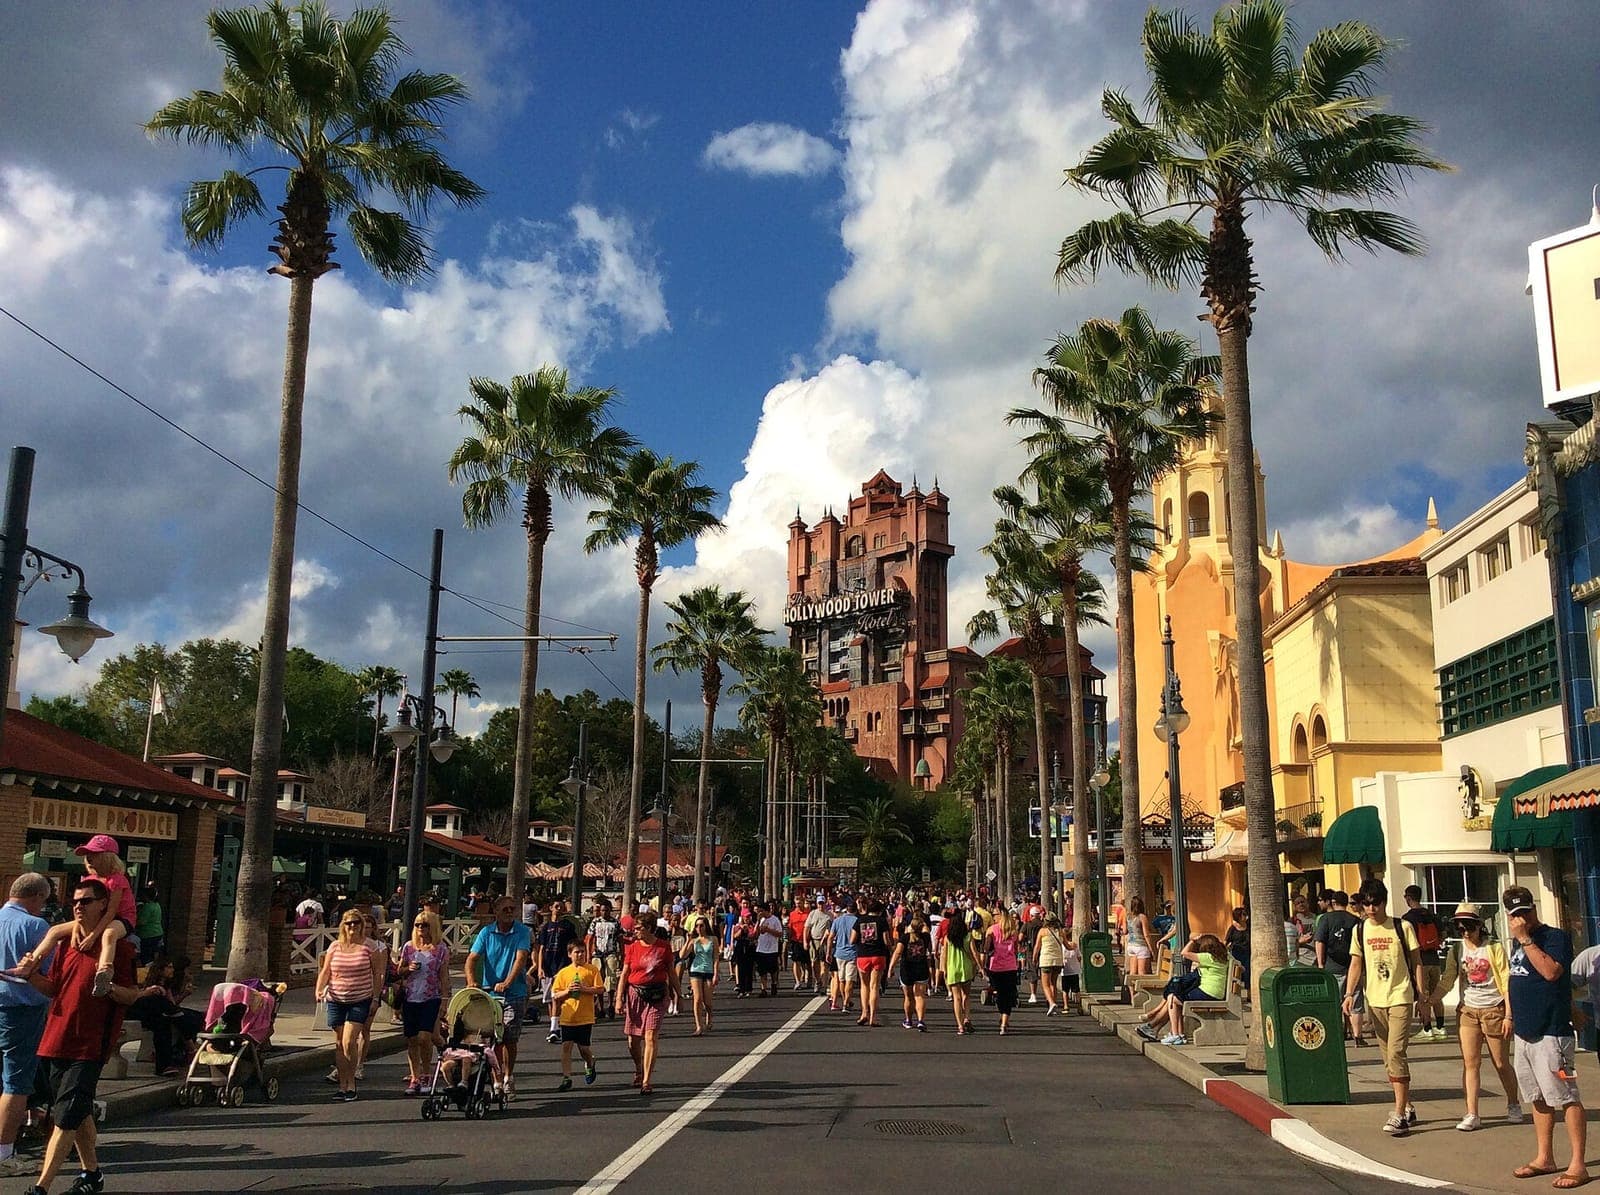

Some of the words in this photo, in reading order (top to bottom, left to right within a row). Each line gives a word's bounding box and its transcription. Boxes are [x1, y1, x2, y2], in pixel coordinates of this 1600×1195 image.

[783, 597, 851, 623] HOLLYWOOD
[855, 588, 895, 610] TOWER
[857, 607, 895, 631] Hotel
[106, 810, 172, 836] PRODUCE
[1290, 985, 1321, 997] PUSH
